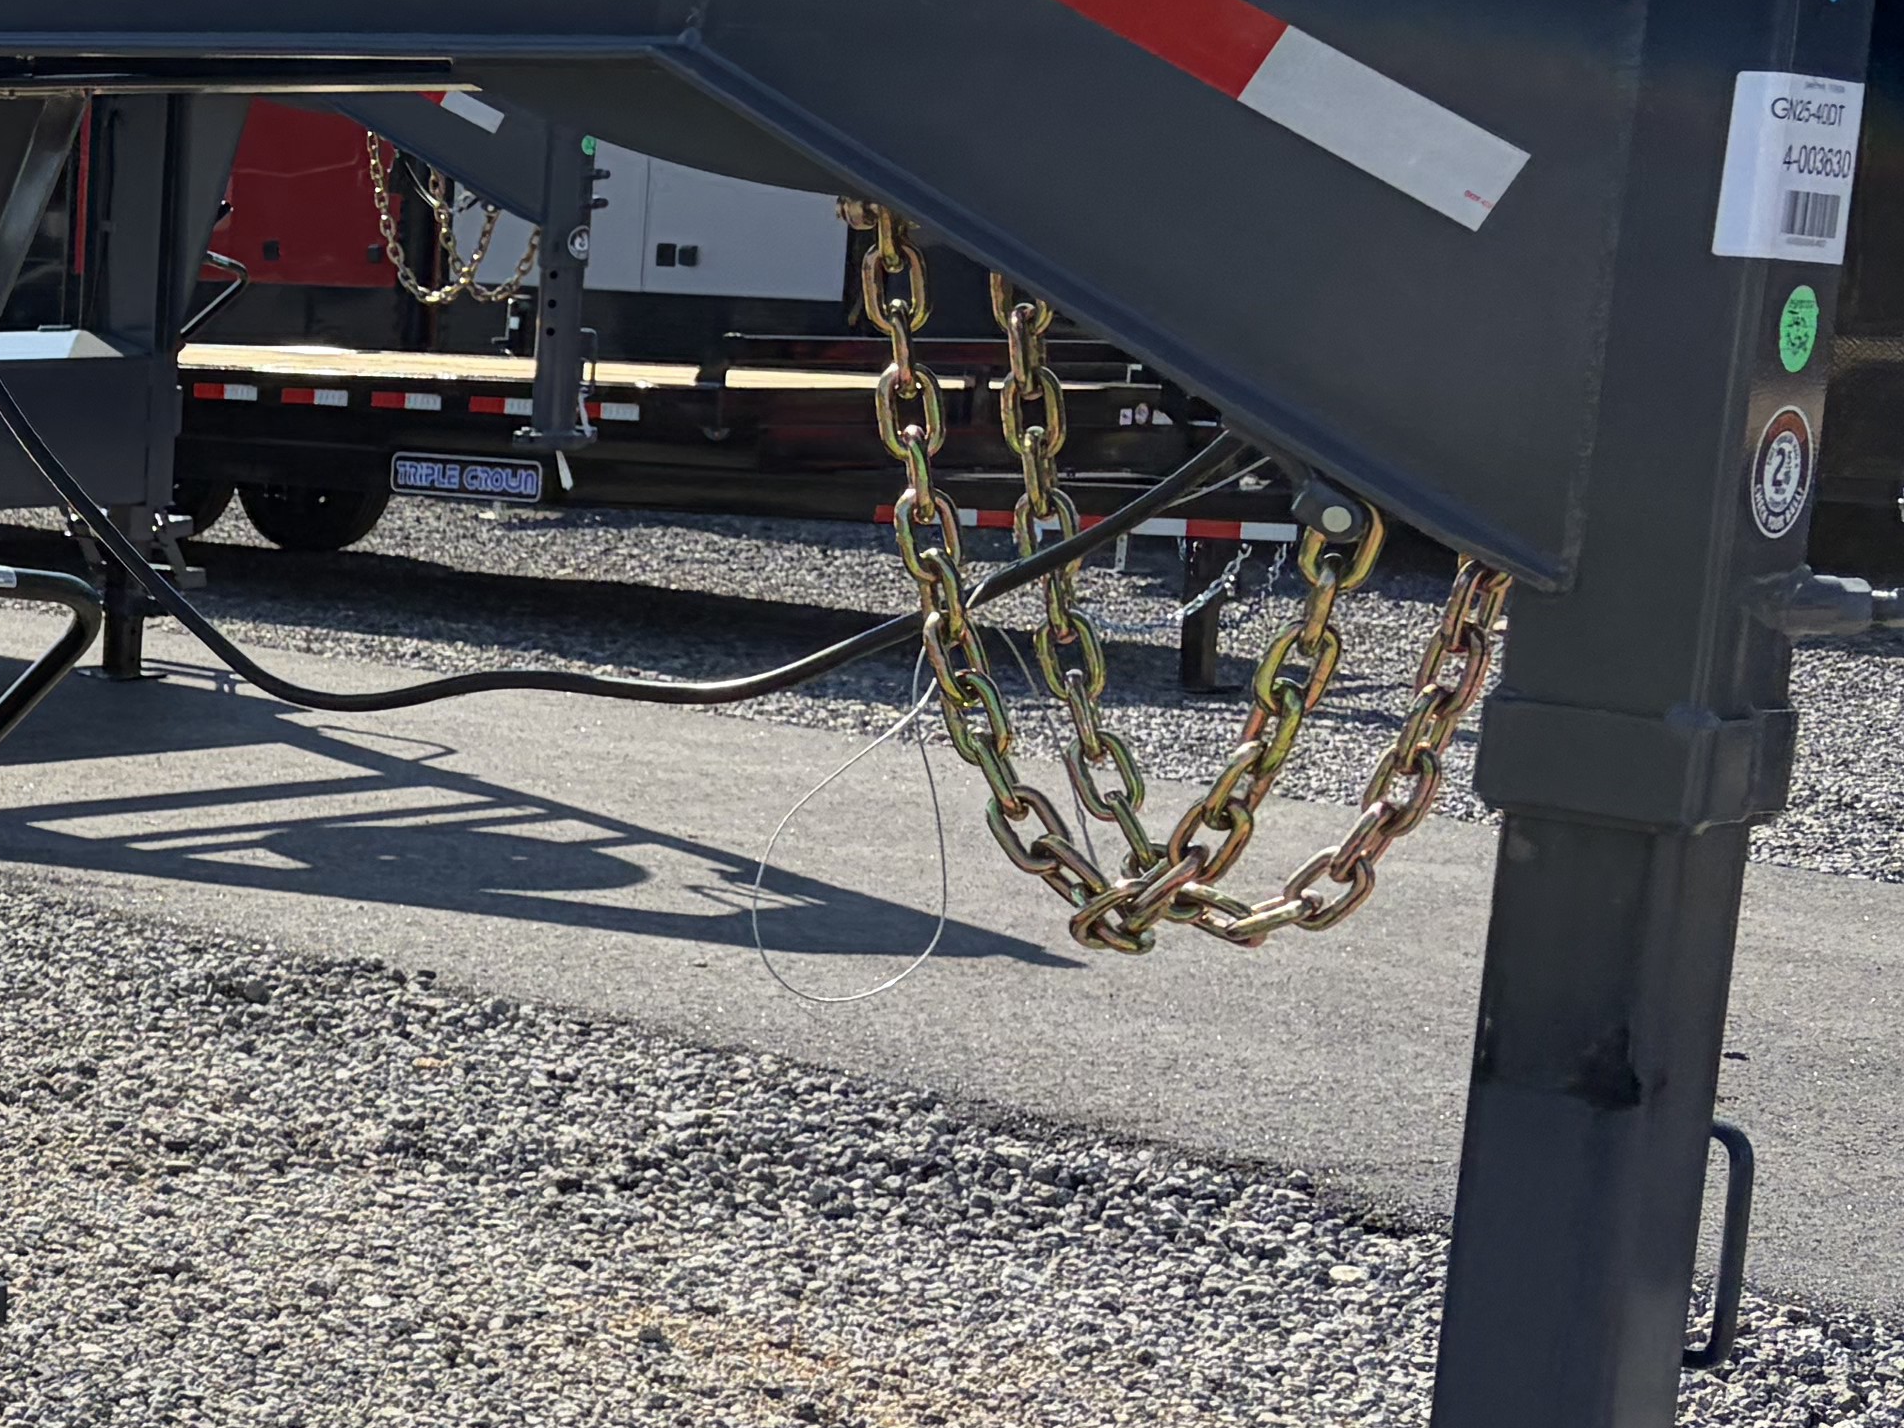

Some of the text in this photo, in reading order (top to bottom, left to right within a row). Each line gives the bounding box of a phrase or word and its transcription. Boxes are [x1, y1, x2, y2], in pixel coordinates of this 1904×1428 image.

[1771, 97, 1845, 127] GN25-40DT
[1782, 144, 1852, 179] 4-003630
[396, 460, 538, 495] TRIPLE CROWN
